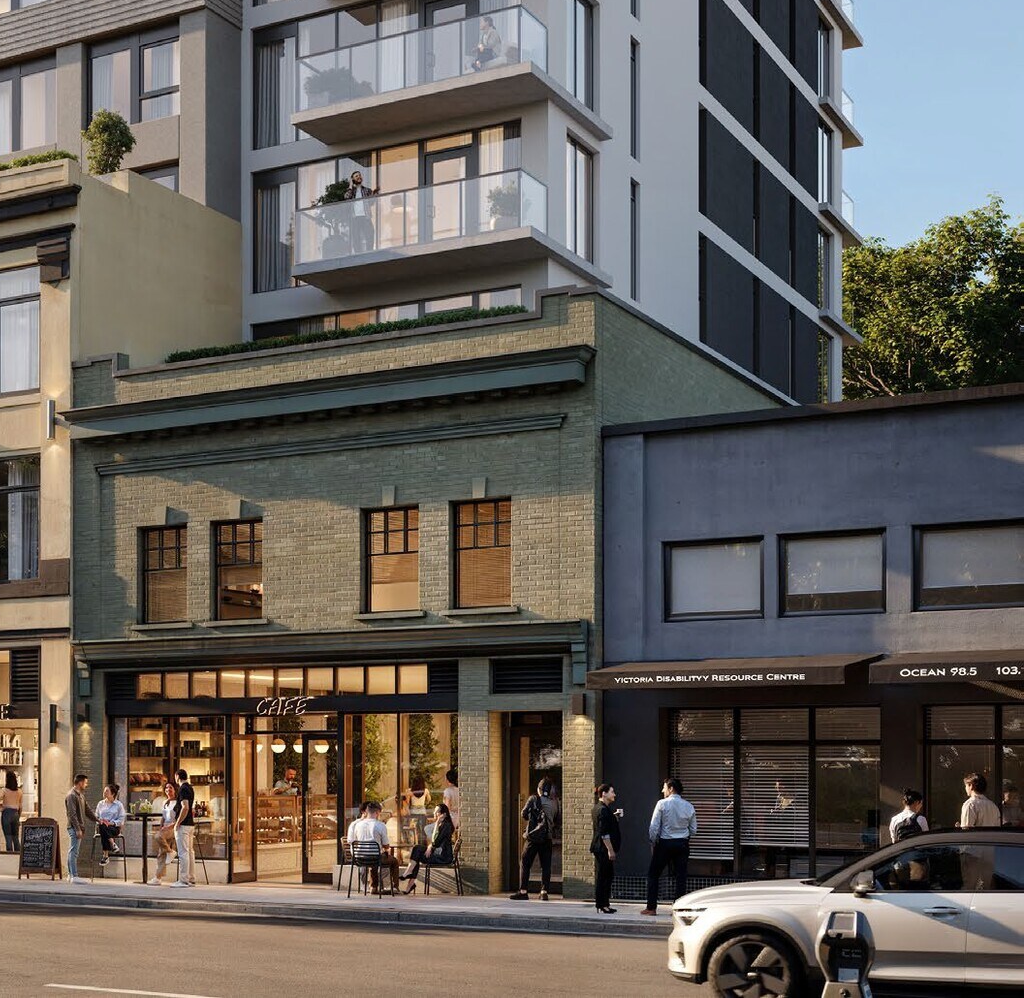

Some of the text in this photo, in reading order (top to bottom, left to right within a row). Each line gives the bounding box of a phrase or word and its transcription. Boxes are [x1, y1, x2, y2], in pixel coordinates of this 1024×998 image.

[899, 665, 1024, 678] OCEAN 98.5 103.
[613, 676, 655, 685] VICTORIA
[711, 673, 764, 682] RESOURCE
[765, 672, 806, 681] CENTRE
